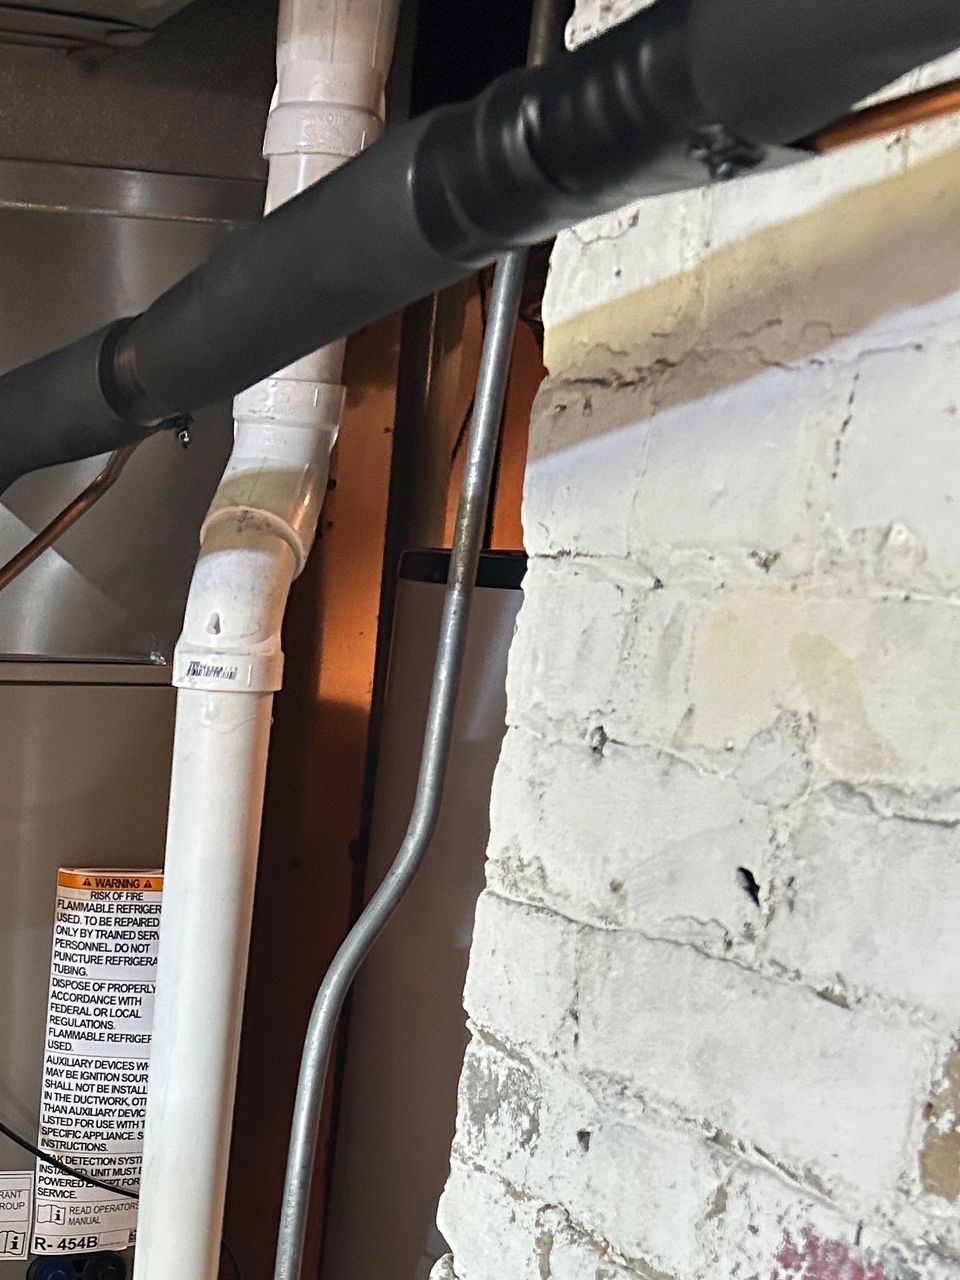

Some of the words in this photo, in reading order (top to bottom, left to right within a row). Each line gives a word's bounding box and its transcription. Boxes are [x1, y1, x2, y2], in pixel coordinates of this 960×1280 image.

[95, 878, 140, 889] WARNING
[90, 891, 111, 900] RISK
[113, 892, 124, 900] OF
[125, 892, 143, 901] FIRE
[57, 900, 114, 913] FLAMMABLE
[116, 904, 161, 914] REFRIGER
[56, 913, 82, 924] USED.
[84, 916, 97, 926] TO
[99, 917, 112, 926] BE
[114, 917, 159, 927] REPAIRED
[56, 925, 78, 937] ONLY
[80, 928, 93, 938] BY
[95, 929, 136, 940] TRAINED
[55, 938, 112, 952] PERSONNEL.
[115, 943, 129, 953] DO
[130, 944, 151, 953] NOT
[53, 951, 104, 965] PUNCTURE
[53, 963, 88, 976] TUBING.
[52, 978, 91, 991] DISPOSE
[92, 982, 106, 991] OF
[107, 984, 156, 993] PROPERLY
[51, 991, 117, 1005] ACCORDANCE
[118, 996, 142, 1006] WITH
[51, 1003, 92, 1017] FEDERAL
[93, 1007, 109, 1017] OR
[109, 1008, 141, 1018] LOCAL
[50, 1016, 115, 1030] REGULATIONS.
[48, 1028, 105, 1041] FLAMMABLE
[47, 1039, 74, 1051] USED.
[46, 1055, 93, 1069] AUXILIARY
[94, 1058, 135, 1070] DEVICES
[45, 1068, 64, 1079] MAY
[66, 1070, 79, 1080] BE
[80, 1070, 120, 1082] IGNITION
[121, 1072, 148, 1083] SOUR
[45, 1079, 73, 1092] SHALL
[75, 1082, 95, 1093] NOT
[96, 1084, 110, 1093] BE
[44, 1092, 53, 1101] IN
[54, 1093, 72, 1103] THE
[73, 1094, 130, 1107] DUCTWORK,
[43, 1103, 68, 1115] THAN
[68, 1106, 116, 1117] AUXILIARY
[42, 1115, 73, 1127] LISTED
[75, 1117, 94, 1128] FOR
[95, 1118, 114, 1129] USE
[115, 1118, 140, 1129] WITH
[41, 1127, 82, 1139] SPECIFIC
[82, 1129, 135, 1140] APPLIANCE.
[41, 1139, 108, 1152] INSTRUCTIONS.
[65, 1156, 117, 1165] DETECTION
[91, 1168, 112, 1176] UNIT
[113, 1168, 138, 1176] MUST
[39, 1176, 84, 1187] POWERED
[122, 1178, 140, 1186] FOR
[38, 1188, 77, 1198] SERVICE.
[69, 1206, 91, 1214] READ
[68, 1216, 100, 1225] MANUAL
[57, 1236, 98, 1250] 454B
